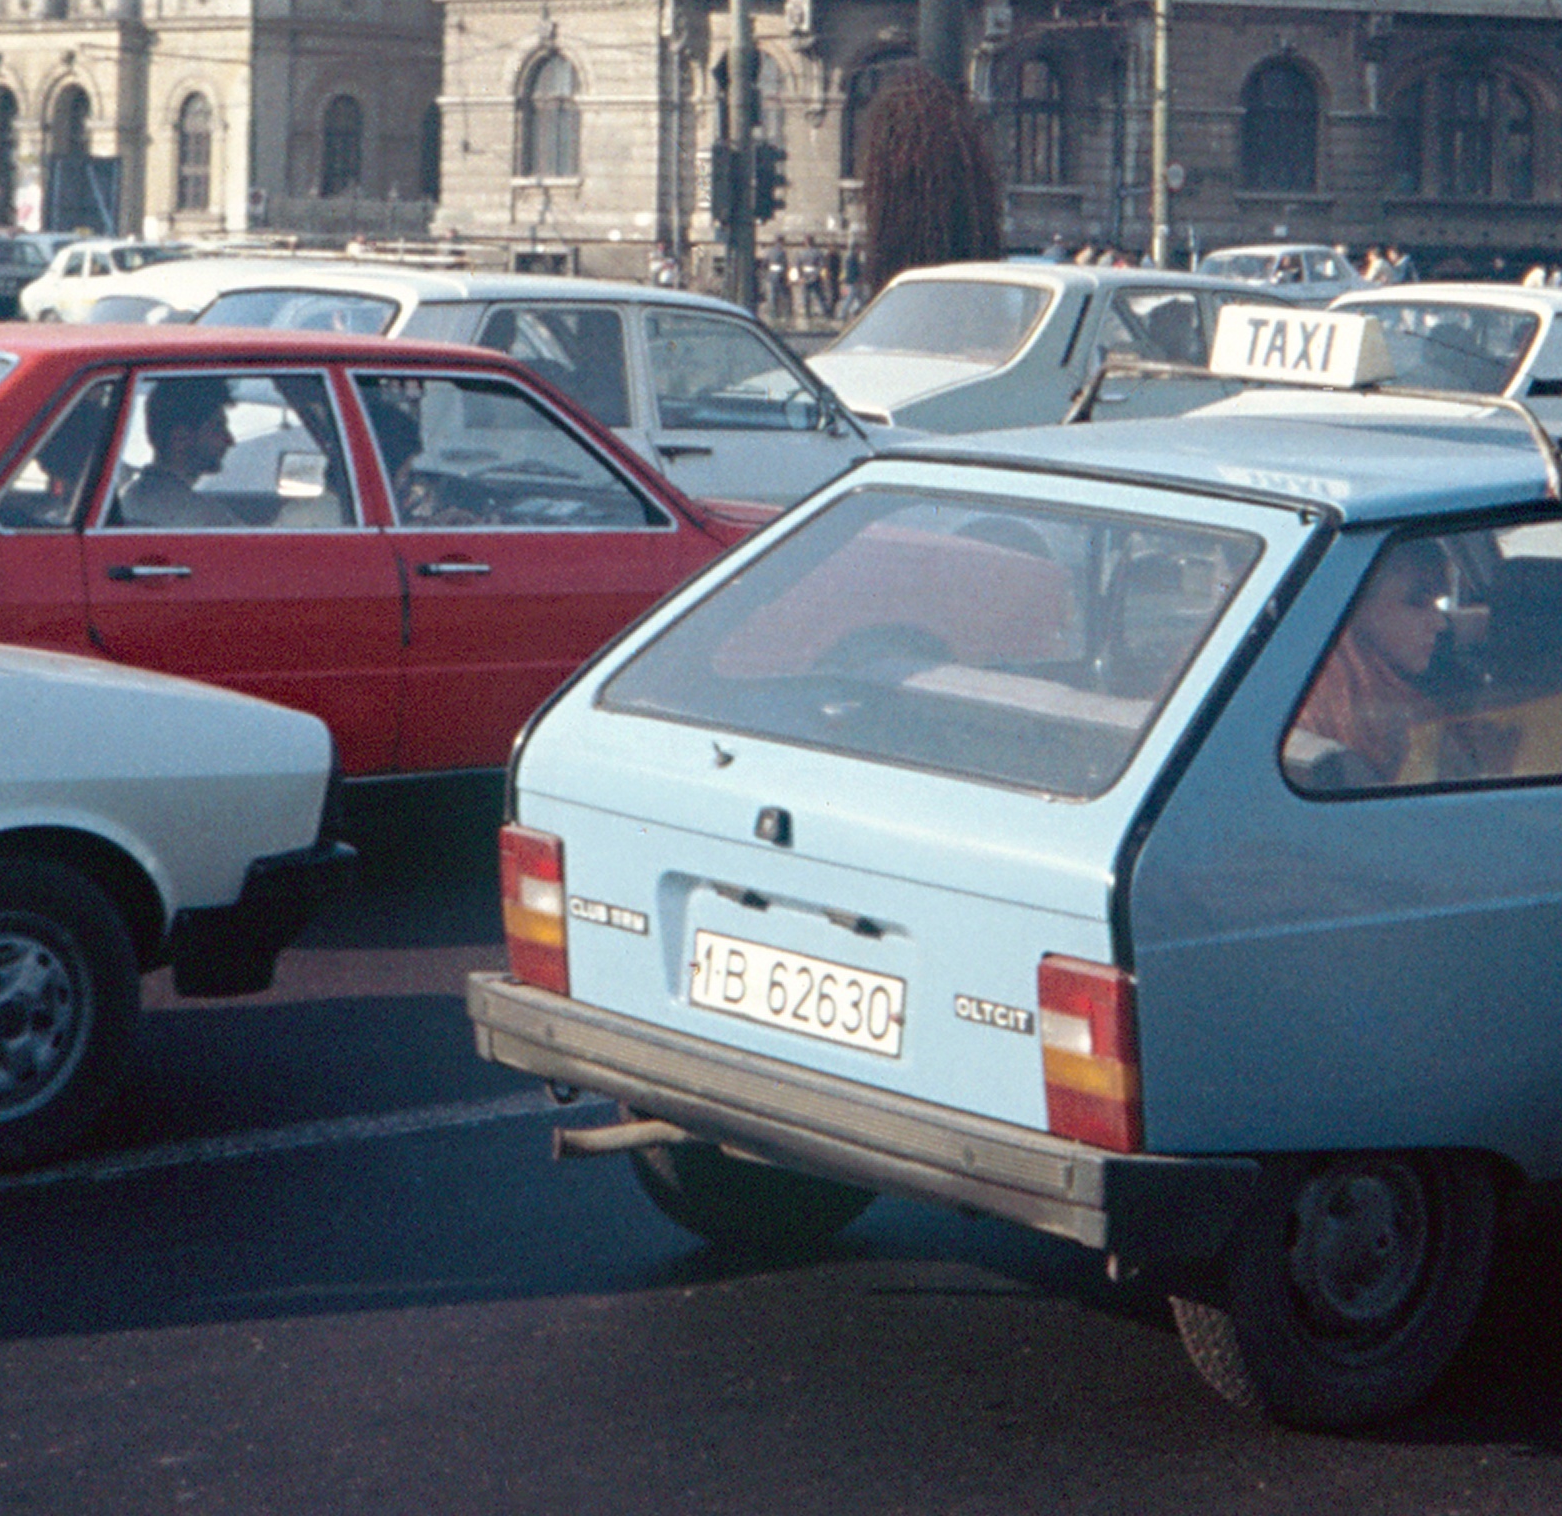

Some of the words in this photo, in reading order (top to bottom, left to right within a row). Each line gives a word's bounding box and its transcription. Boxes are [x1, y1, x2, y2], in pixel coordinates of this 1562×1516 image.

[1248, 317, 1337, 372] TAXI
[767, 961, 891, 1041] 62630
[955, 995, 1029, 1032] OLTCIT
